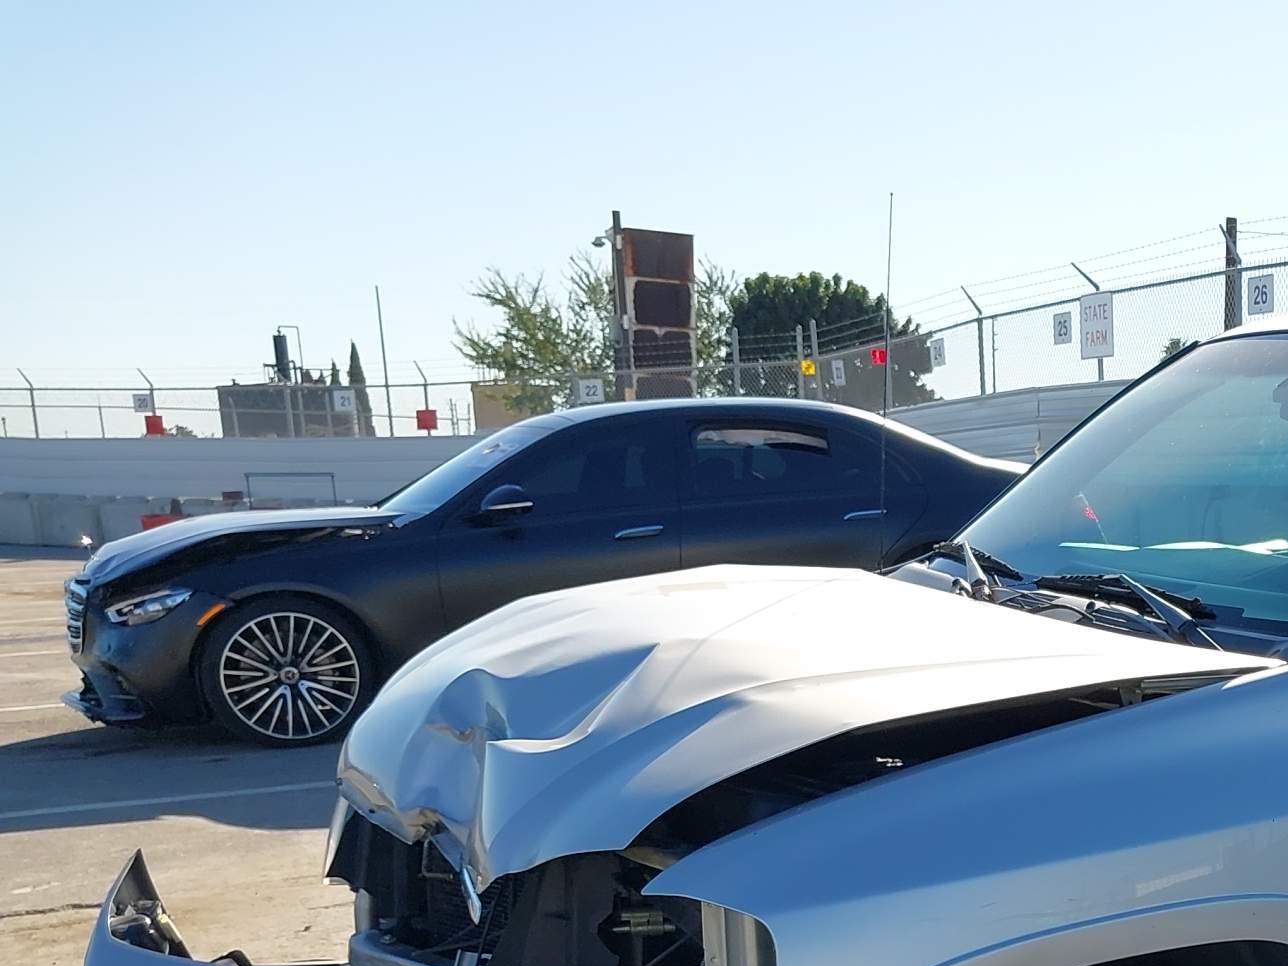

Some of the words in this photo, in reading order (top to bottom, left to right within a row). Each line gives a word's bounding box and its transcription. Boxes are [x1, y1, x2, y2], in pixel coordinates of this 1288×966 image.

[1253, 284, 1268, 305] 26
[1083, 303, 1108, 322] STATE
[1057, 319, 1068, 337] 25
[1085, 329, 1108, 347] FARM
[585, 384, 599, 397] 22
[340, 395, 352, 408] 21
